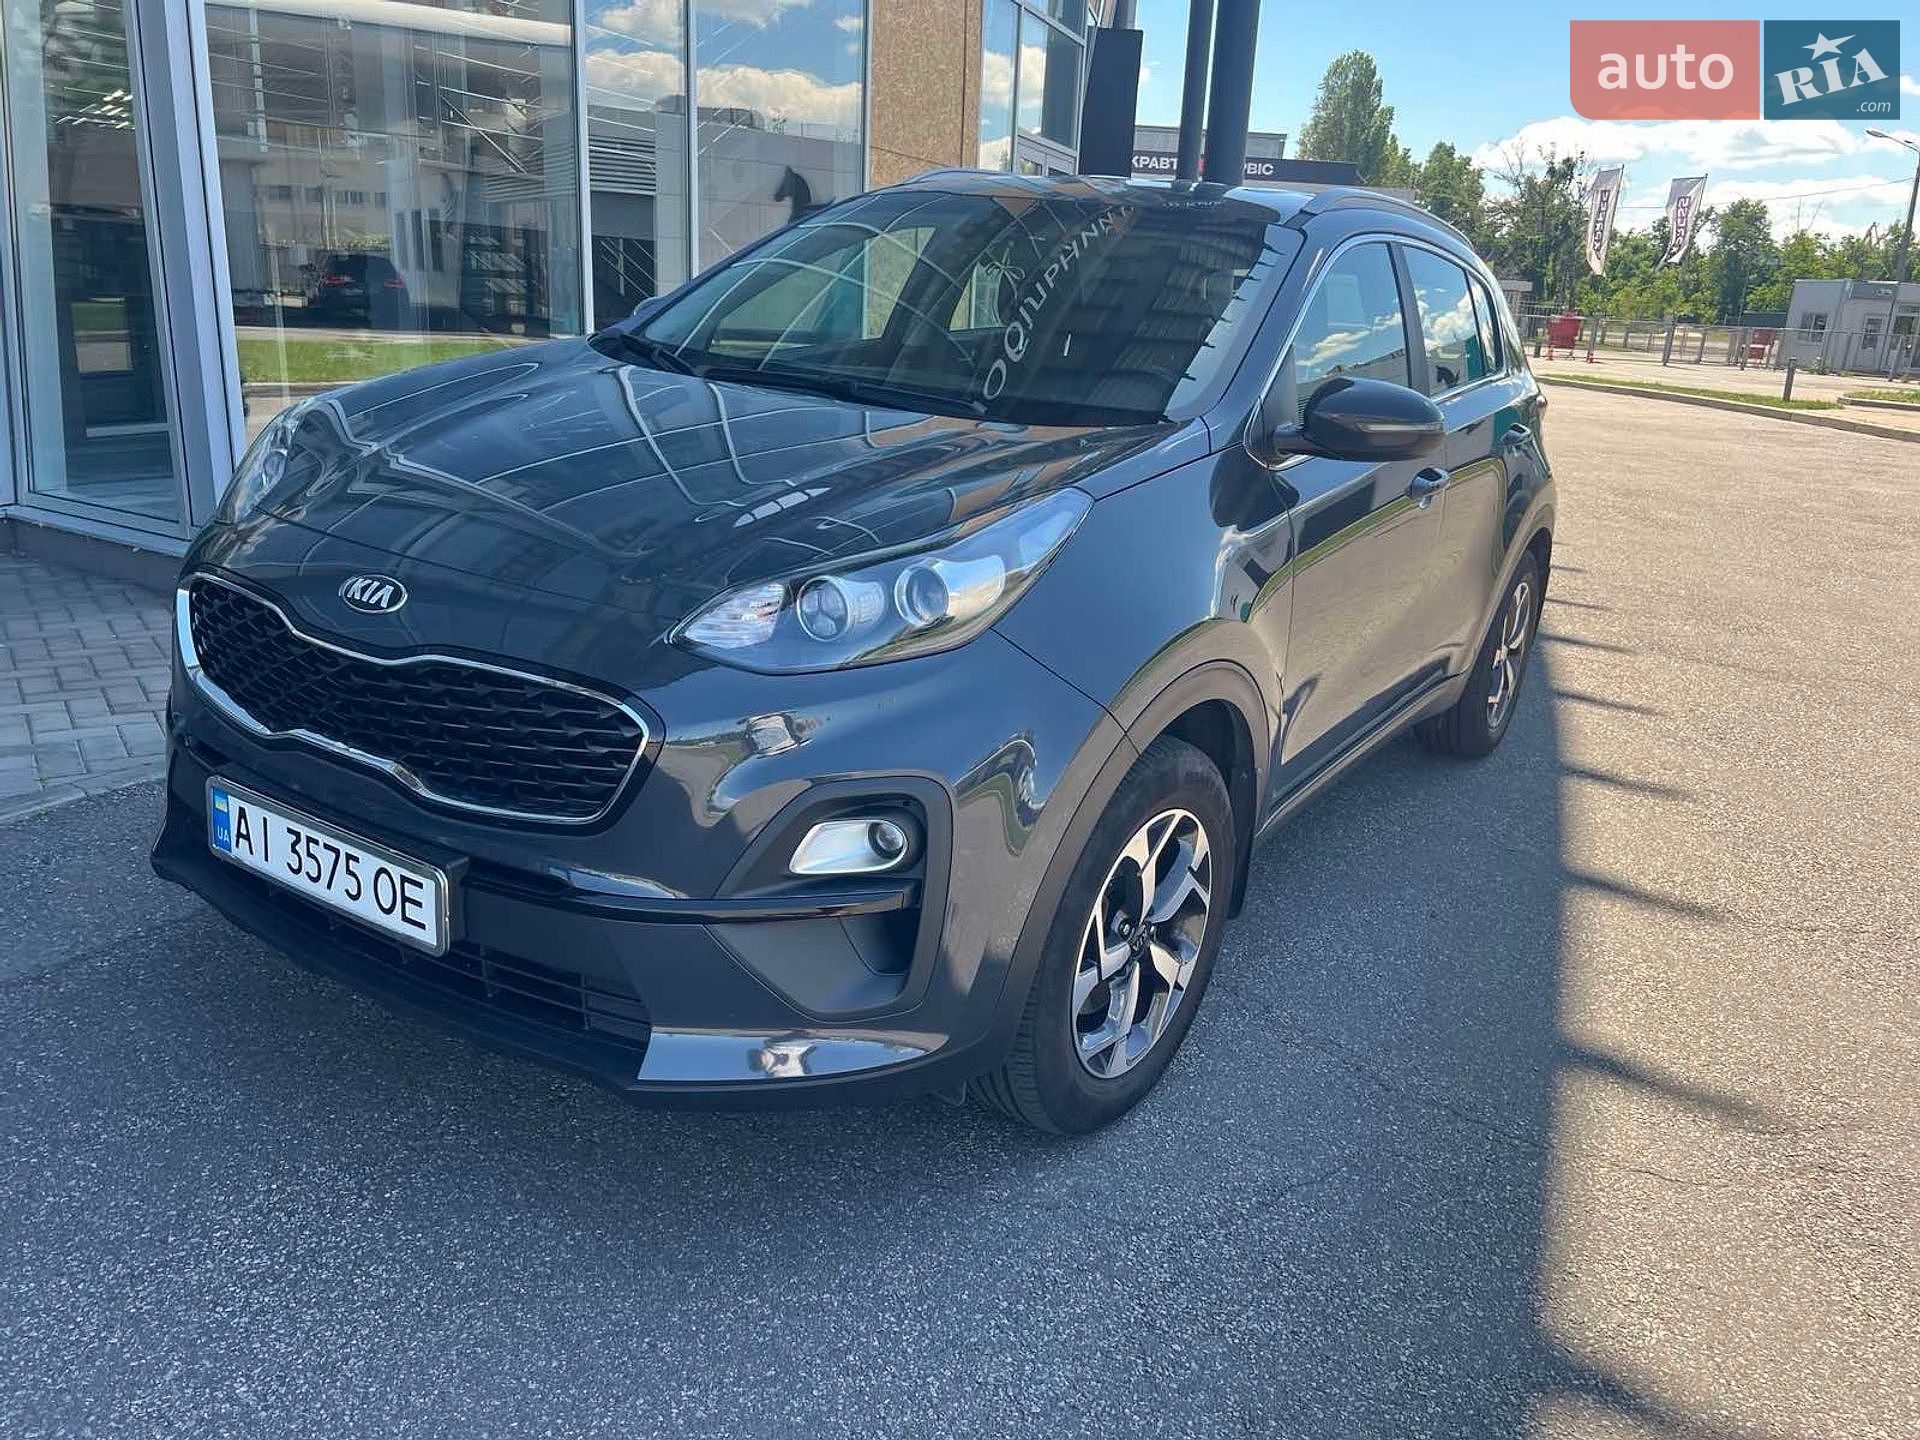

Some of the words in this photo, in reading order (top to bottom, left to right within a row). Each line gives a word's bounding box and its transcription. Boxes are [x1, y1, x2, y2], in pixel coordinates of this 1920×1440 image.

[1244, 163, 1274, 175] ВІС
[347, 578, 394, 608] KIA
[217, 827, 230, 844] UA
[235, 806, 269, 863] AI
[286, 827, 362, 901] 3575
[373, 866, 426, 931] OE
